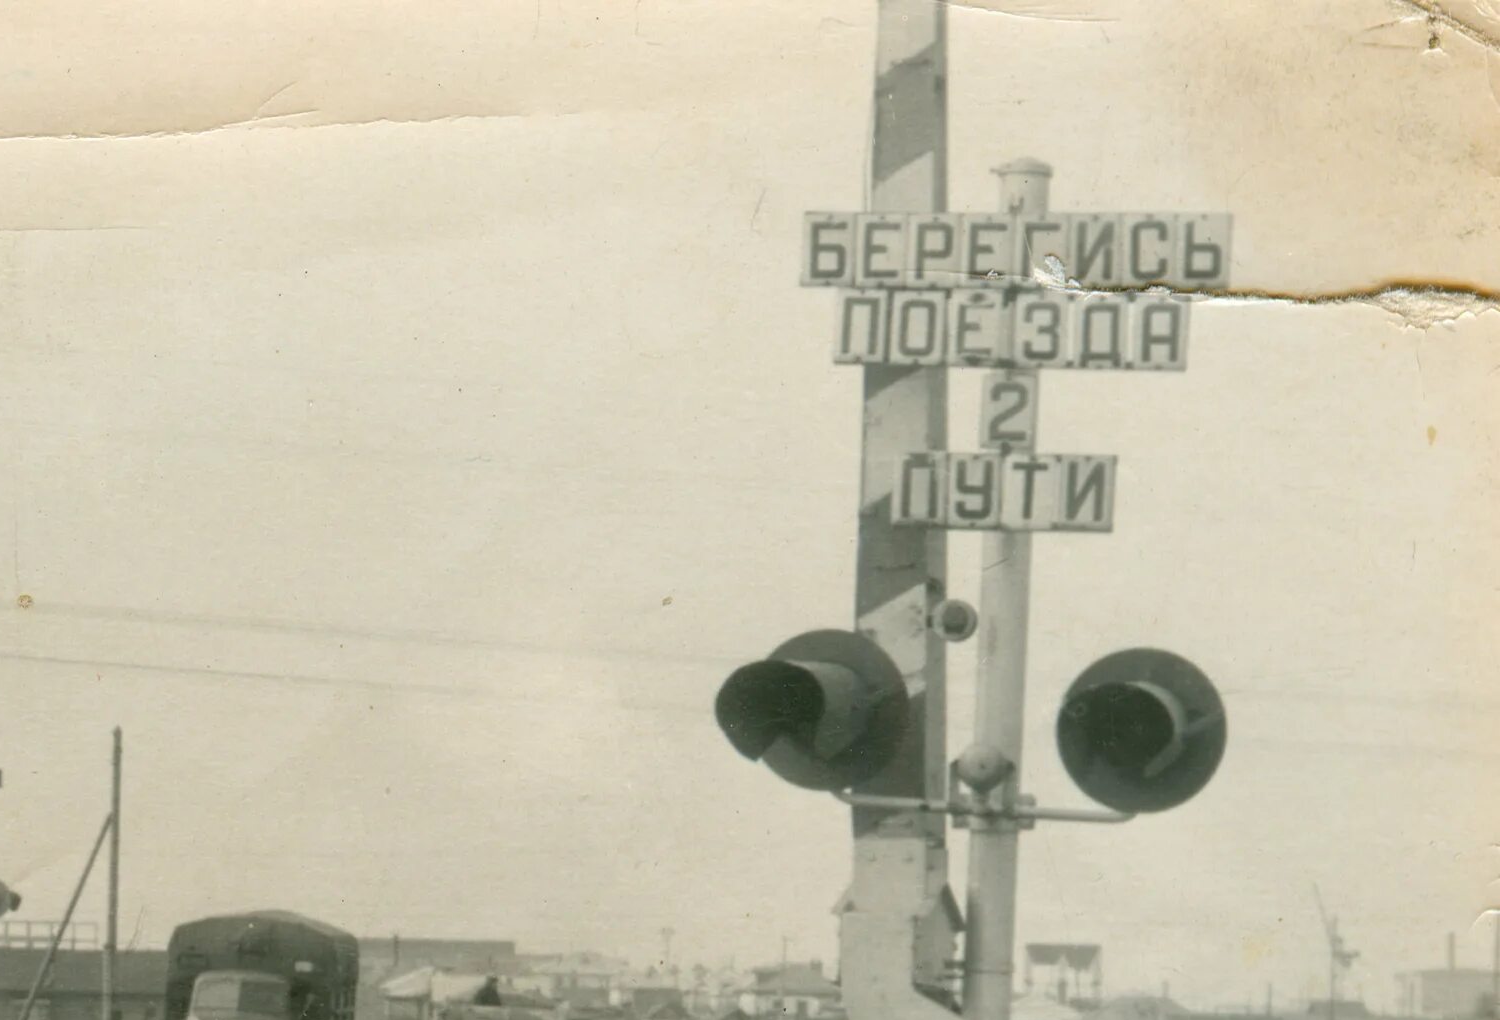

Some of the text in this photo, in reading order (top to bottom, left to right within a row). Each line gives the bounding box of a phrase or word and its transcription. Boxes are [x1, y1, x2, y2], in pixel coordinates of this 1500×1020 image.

[809, 221, 1223, 282] БЕРЕГИСЬ
[840, 296, 1181, 369] ПОЕЗДА
[987, 381, 1028, 442] 2
[901, 459, 1103, 522] ПУТИ
